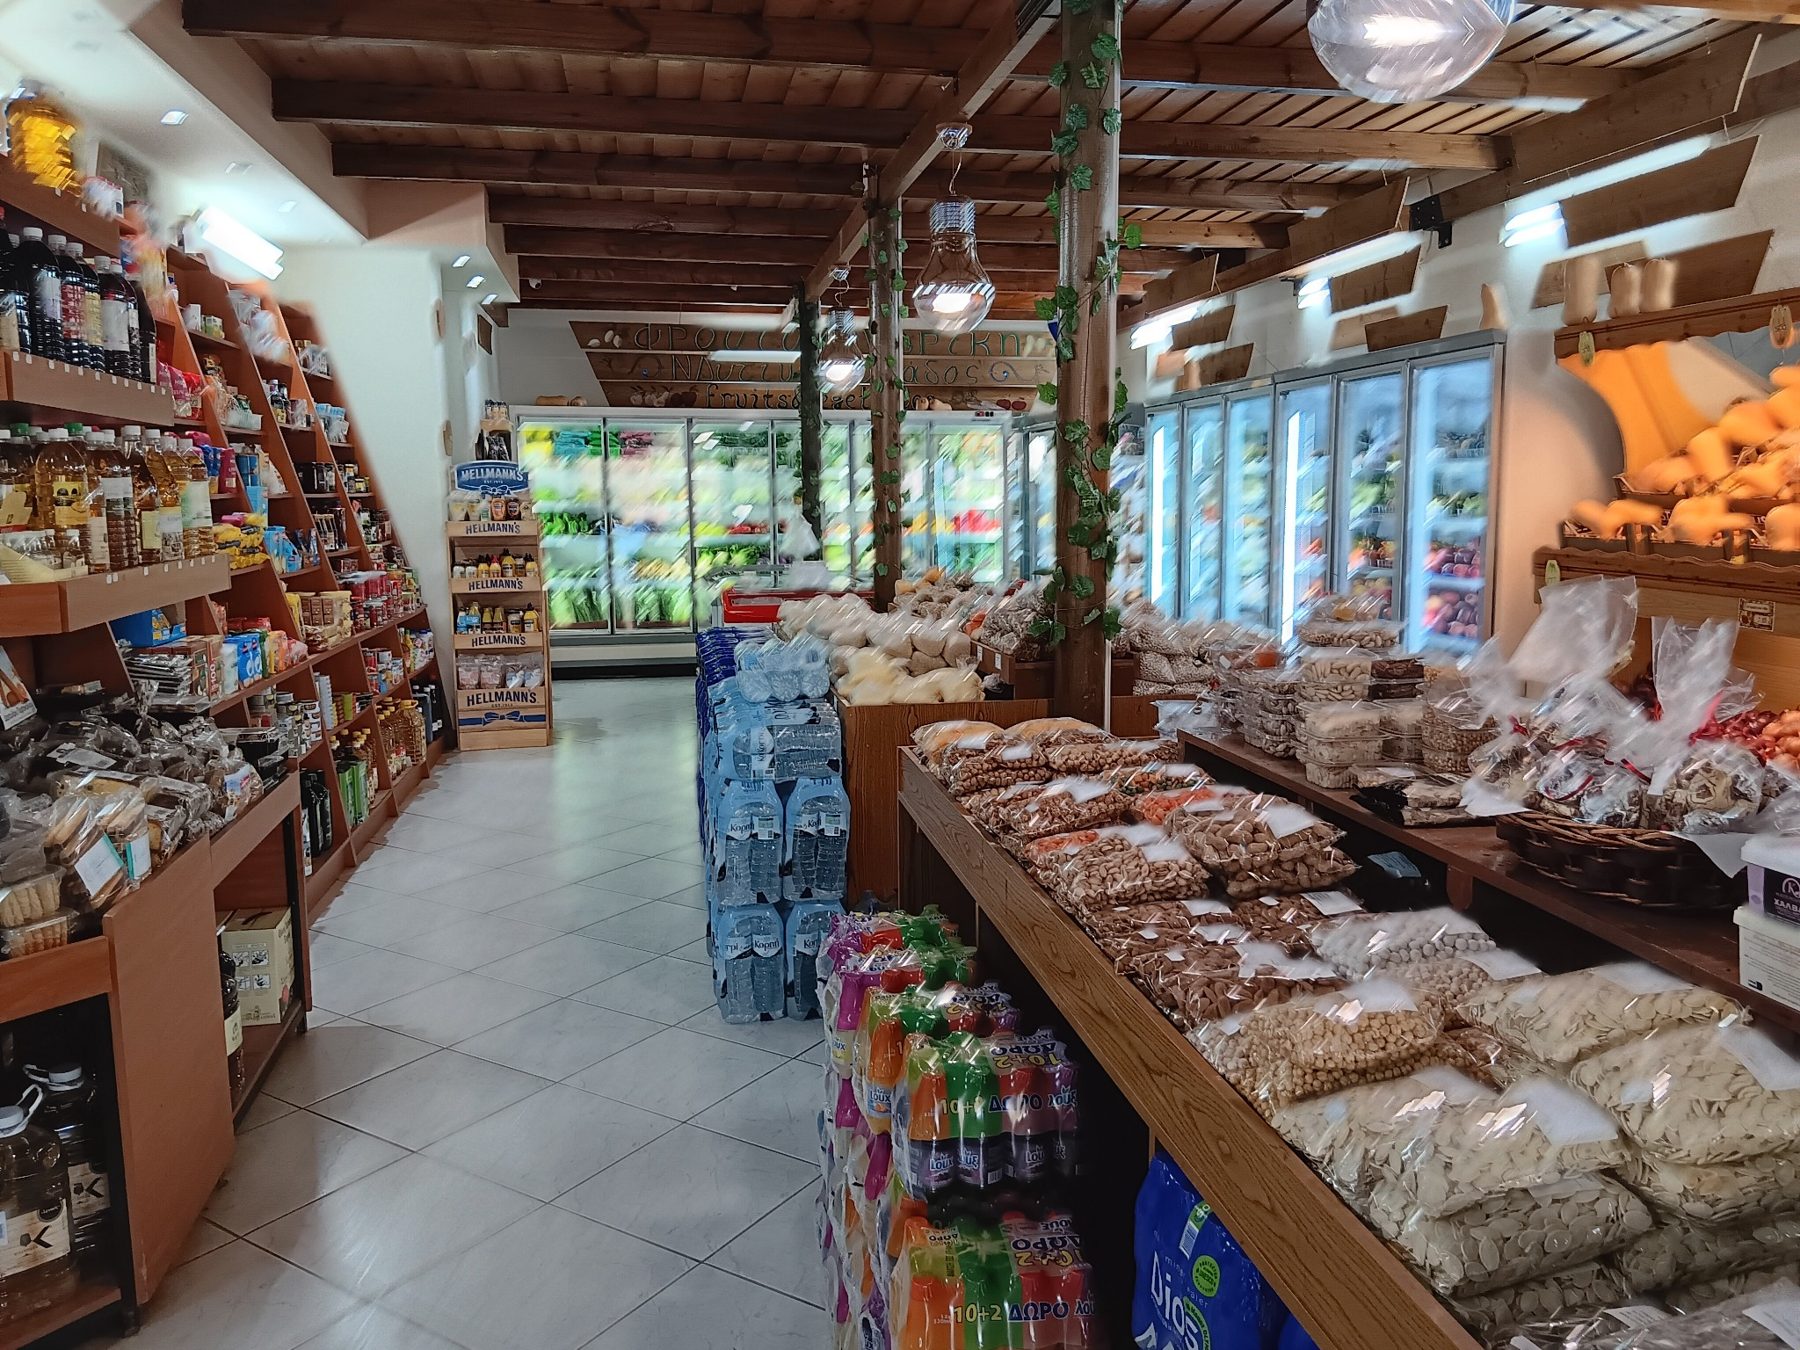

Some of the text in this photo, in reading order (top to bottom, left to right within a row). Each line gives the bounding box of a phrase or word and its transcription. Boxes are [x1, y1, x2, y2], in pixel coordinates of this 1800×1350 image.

[704, 383, 789, 409] fruits
[461, 467, 523, 481] HELLMANN'S
[465, 522, 520, 534] HELLMANN'S
[468, 578, 523, 591] HELLMANN'S
[471, 634, 526, 647] HELLMANN'S
[466, 689, 537, 707] HELLMANN'S
[993, 1053, 1063, 1070] 10+2
[953, 1302, 1002, 1323] 10+2
[1008, 1301, 1070, 1322] ΔΩΡΟ
